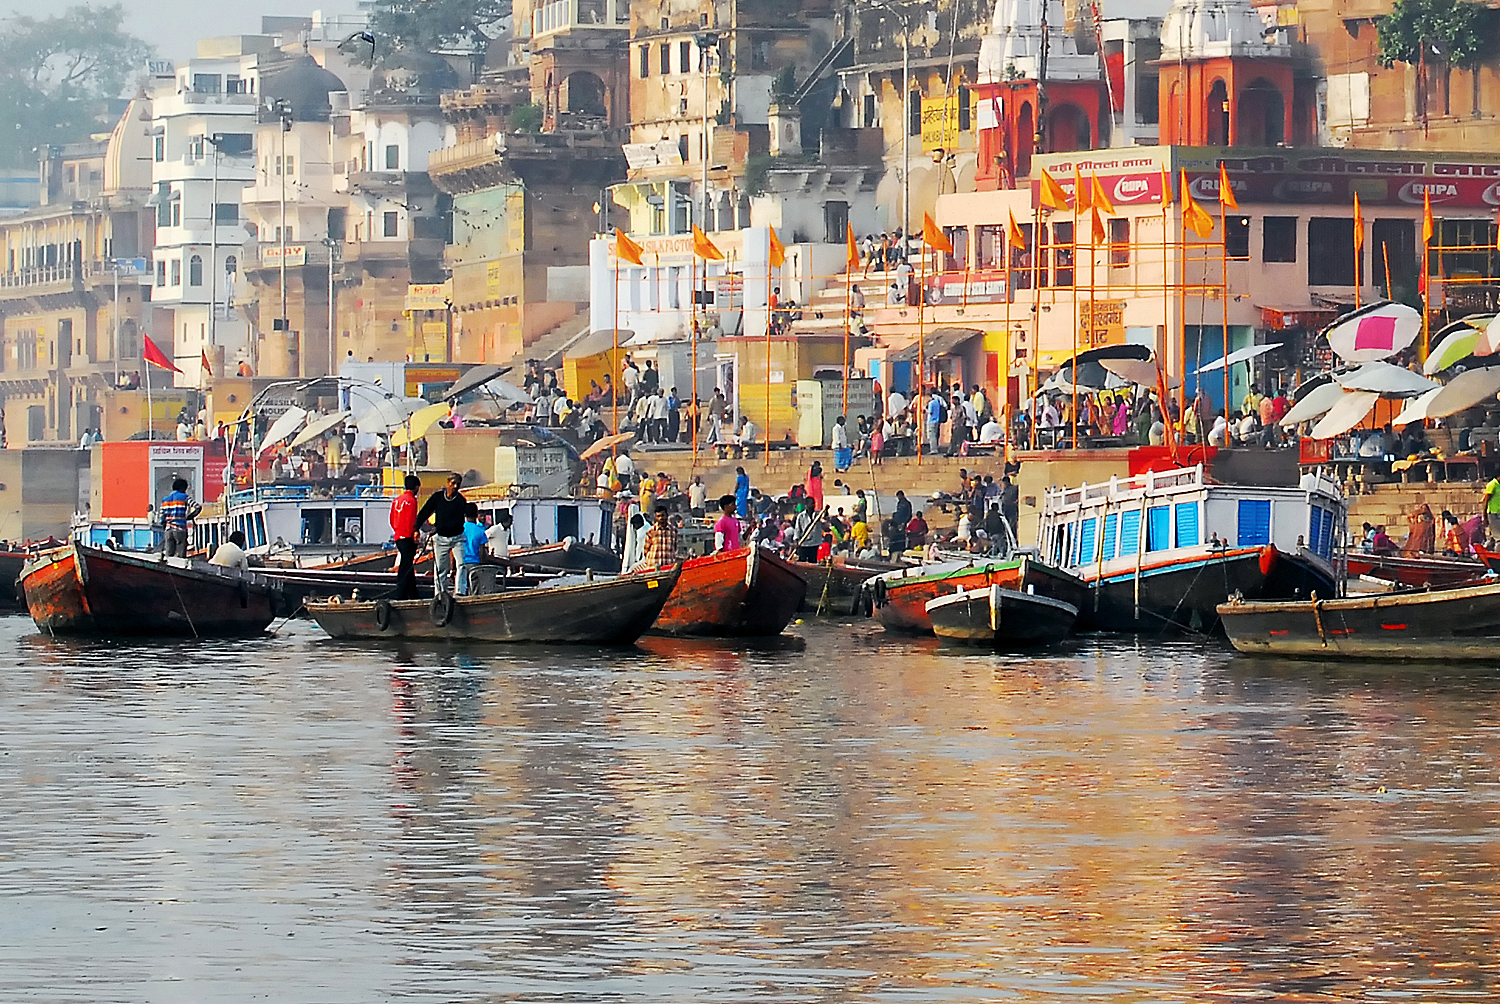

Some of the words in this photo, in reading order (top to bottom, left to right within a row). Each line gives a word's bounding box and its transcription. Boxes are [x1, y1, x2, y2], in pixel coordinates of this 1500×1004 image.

[149, 61, 175, 73] SITA
[1121, 180, 1149, 193] RUPA
[1412, 183, 1458, 196] RUPA
